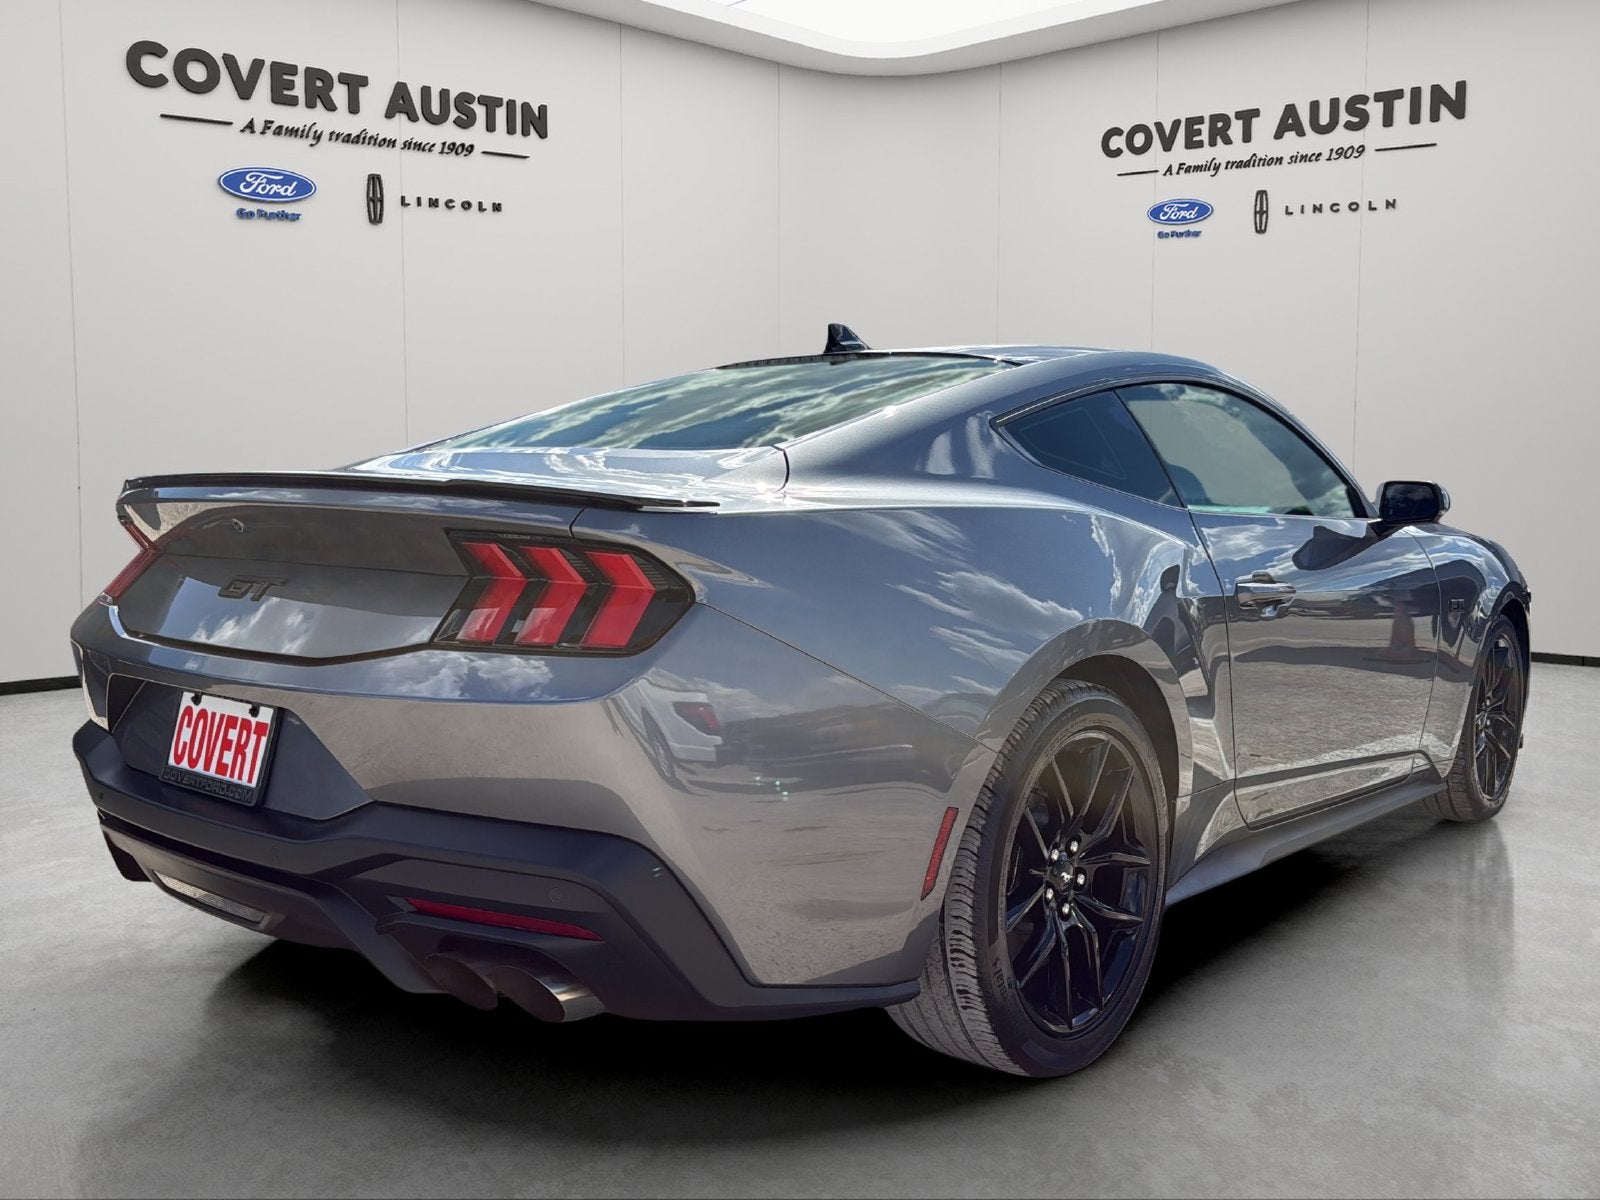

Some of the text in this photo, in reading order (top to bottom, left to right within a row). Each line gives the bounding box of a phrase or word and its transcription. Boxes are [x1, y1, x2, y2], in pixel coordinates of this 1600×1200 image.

[126, 40, 549, 139] COVERT AUSTIN
[1100, 80, 1467, 158] COVERT AUSTIN
[240, 117, 475, 157] A Family tradition since 1909
[1162, 144, 1366, 178] A Family tradition since 1909
[239, 170, 297, 198] Ford
[236, 208, 255, 219] Go
[400, 195, 502, 213] LINCOLN
[1157, 203, 1199, 221] Ford
[1284, 198, 1397, 216] LINCOLN
[1157, 231, 1170, 239] Go
[218, 575, 287, 602] GT
[173, 705, 269, 784] COVERT
[164, 767, 253, 802] COVERTFORD.COM
